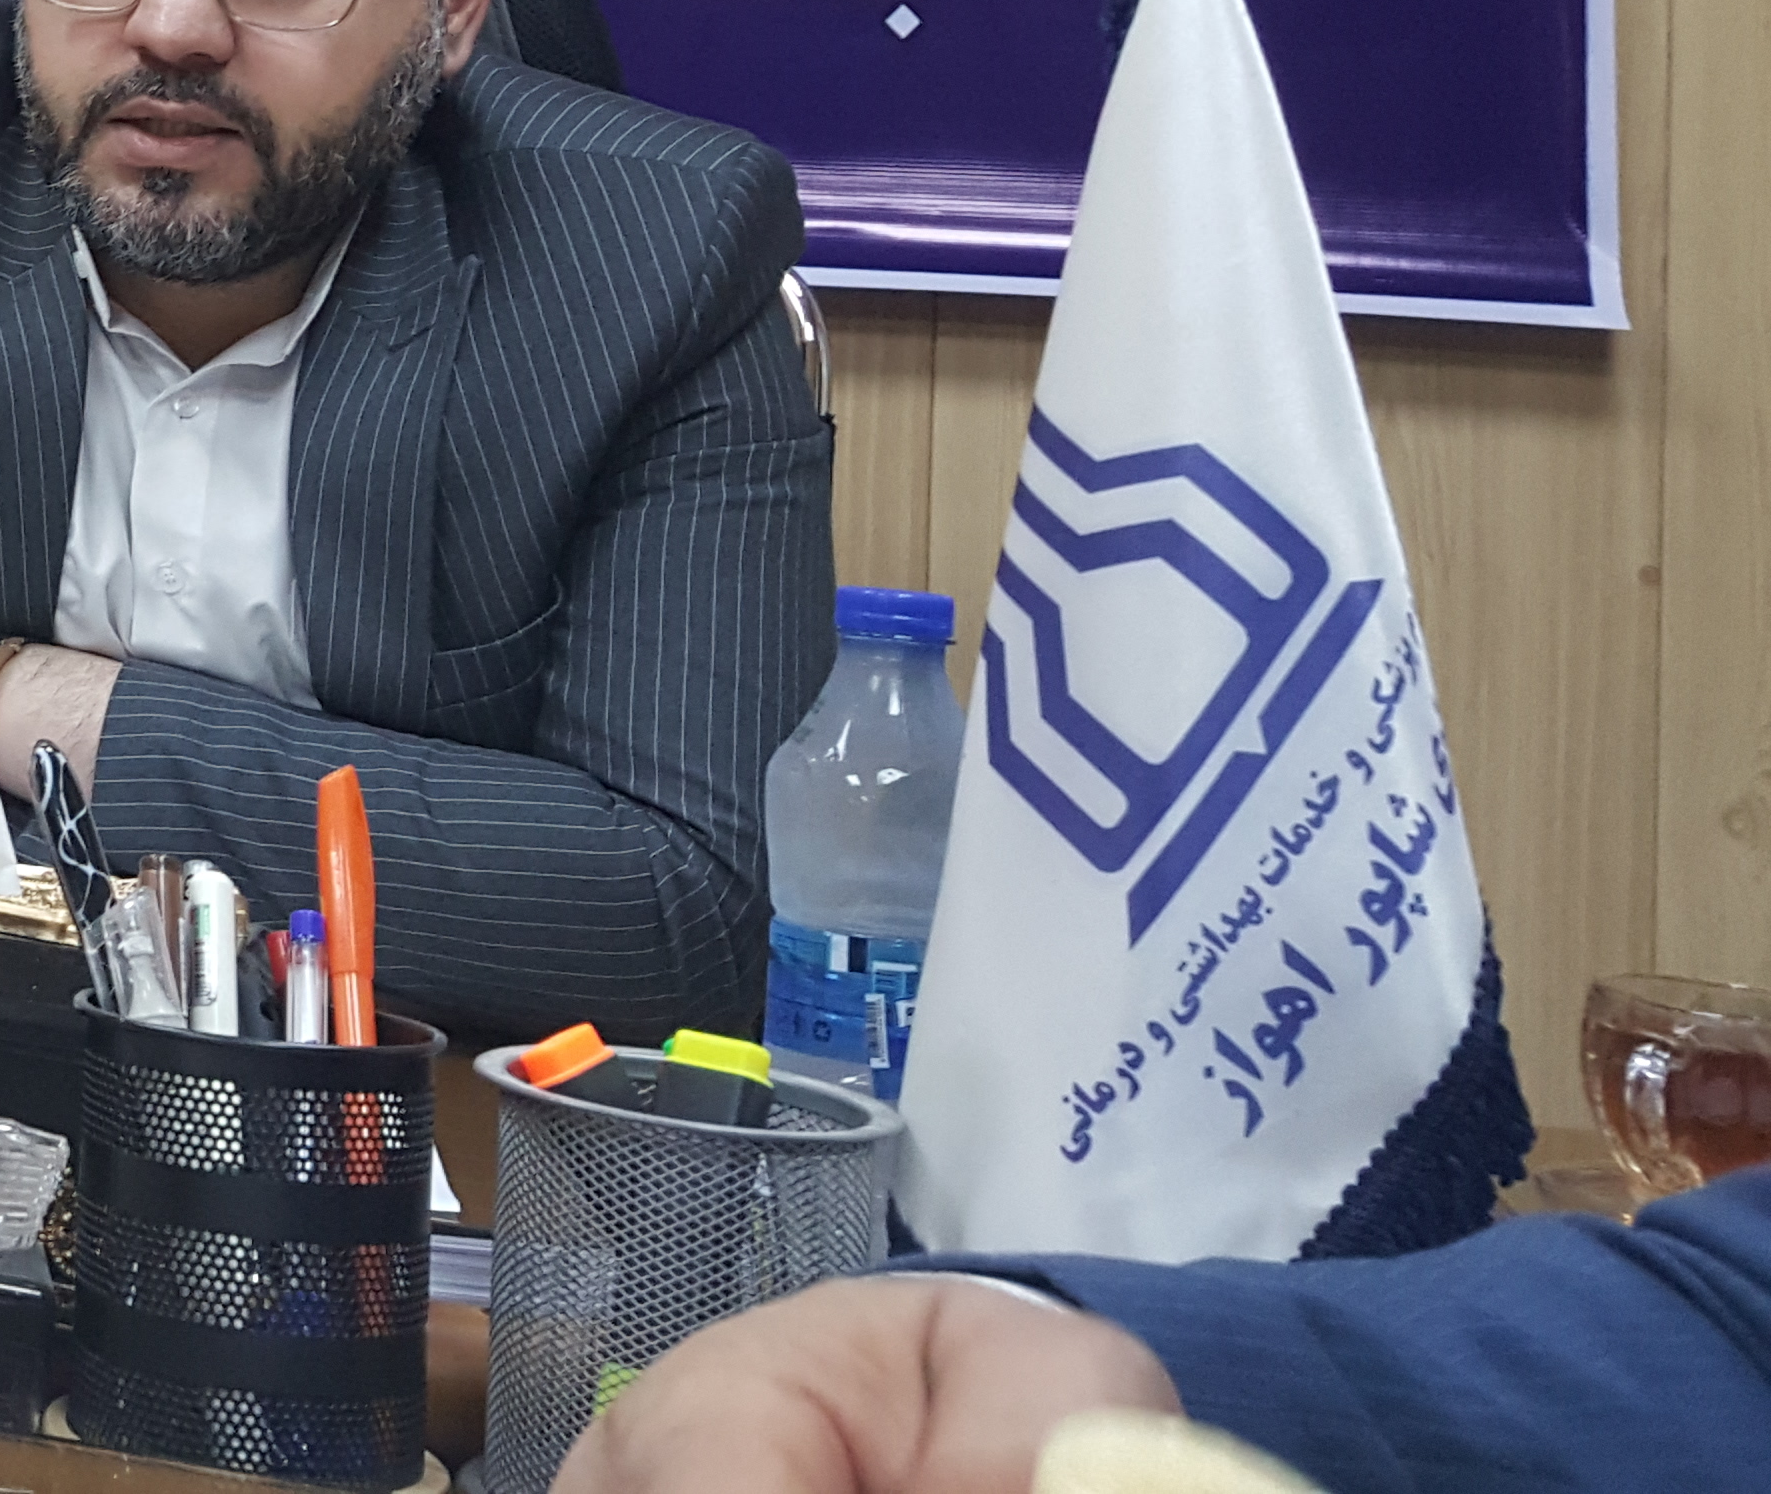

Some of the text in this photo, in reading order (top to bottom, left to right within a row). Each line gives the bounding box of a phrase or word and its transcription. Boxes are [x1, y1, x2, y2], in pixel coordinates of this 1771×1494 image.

[1344, 748, 1376, 787] و
[1260, 768, 1341, 890] خدمات
[1169, 884, 1275, 1026] بهداشتی
[1203, 793, 1440, 1139] شاپور اهواز
[1145, 1019, 1172, 1056] و
[1059, 1041, 1146, 1164] درمانی
